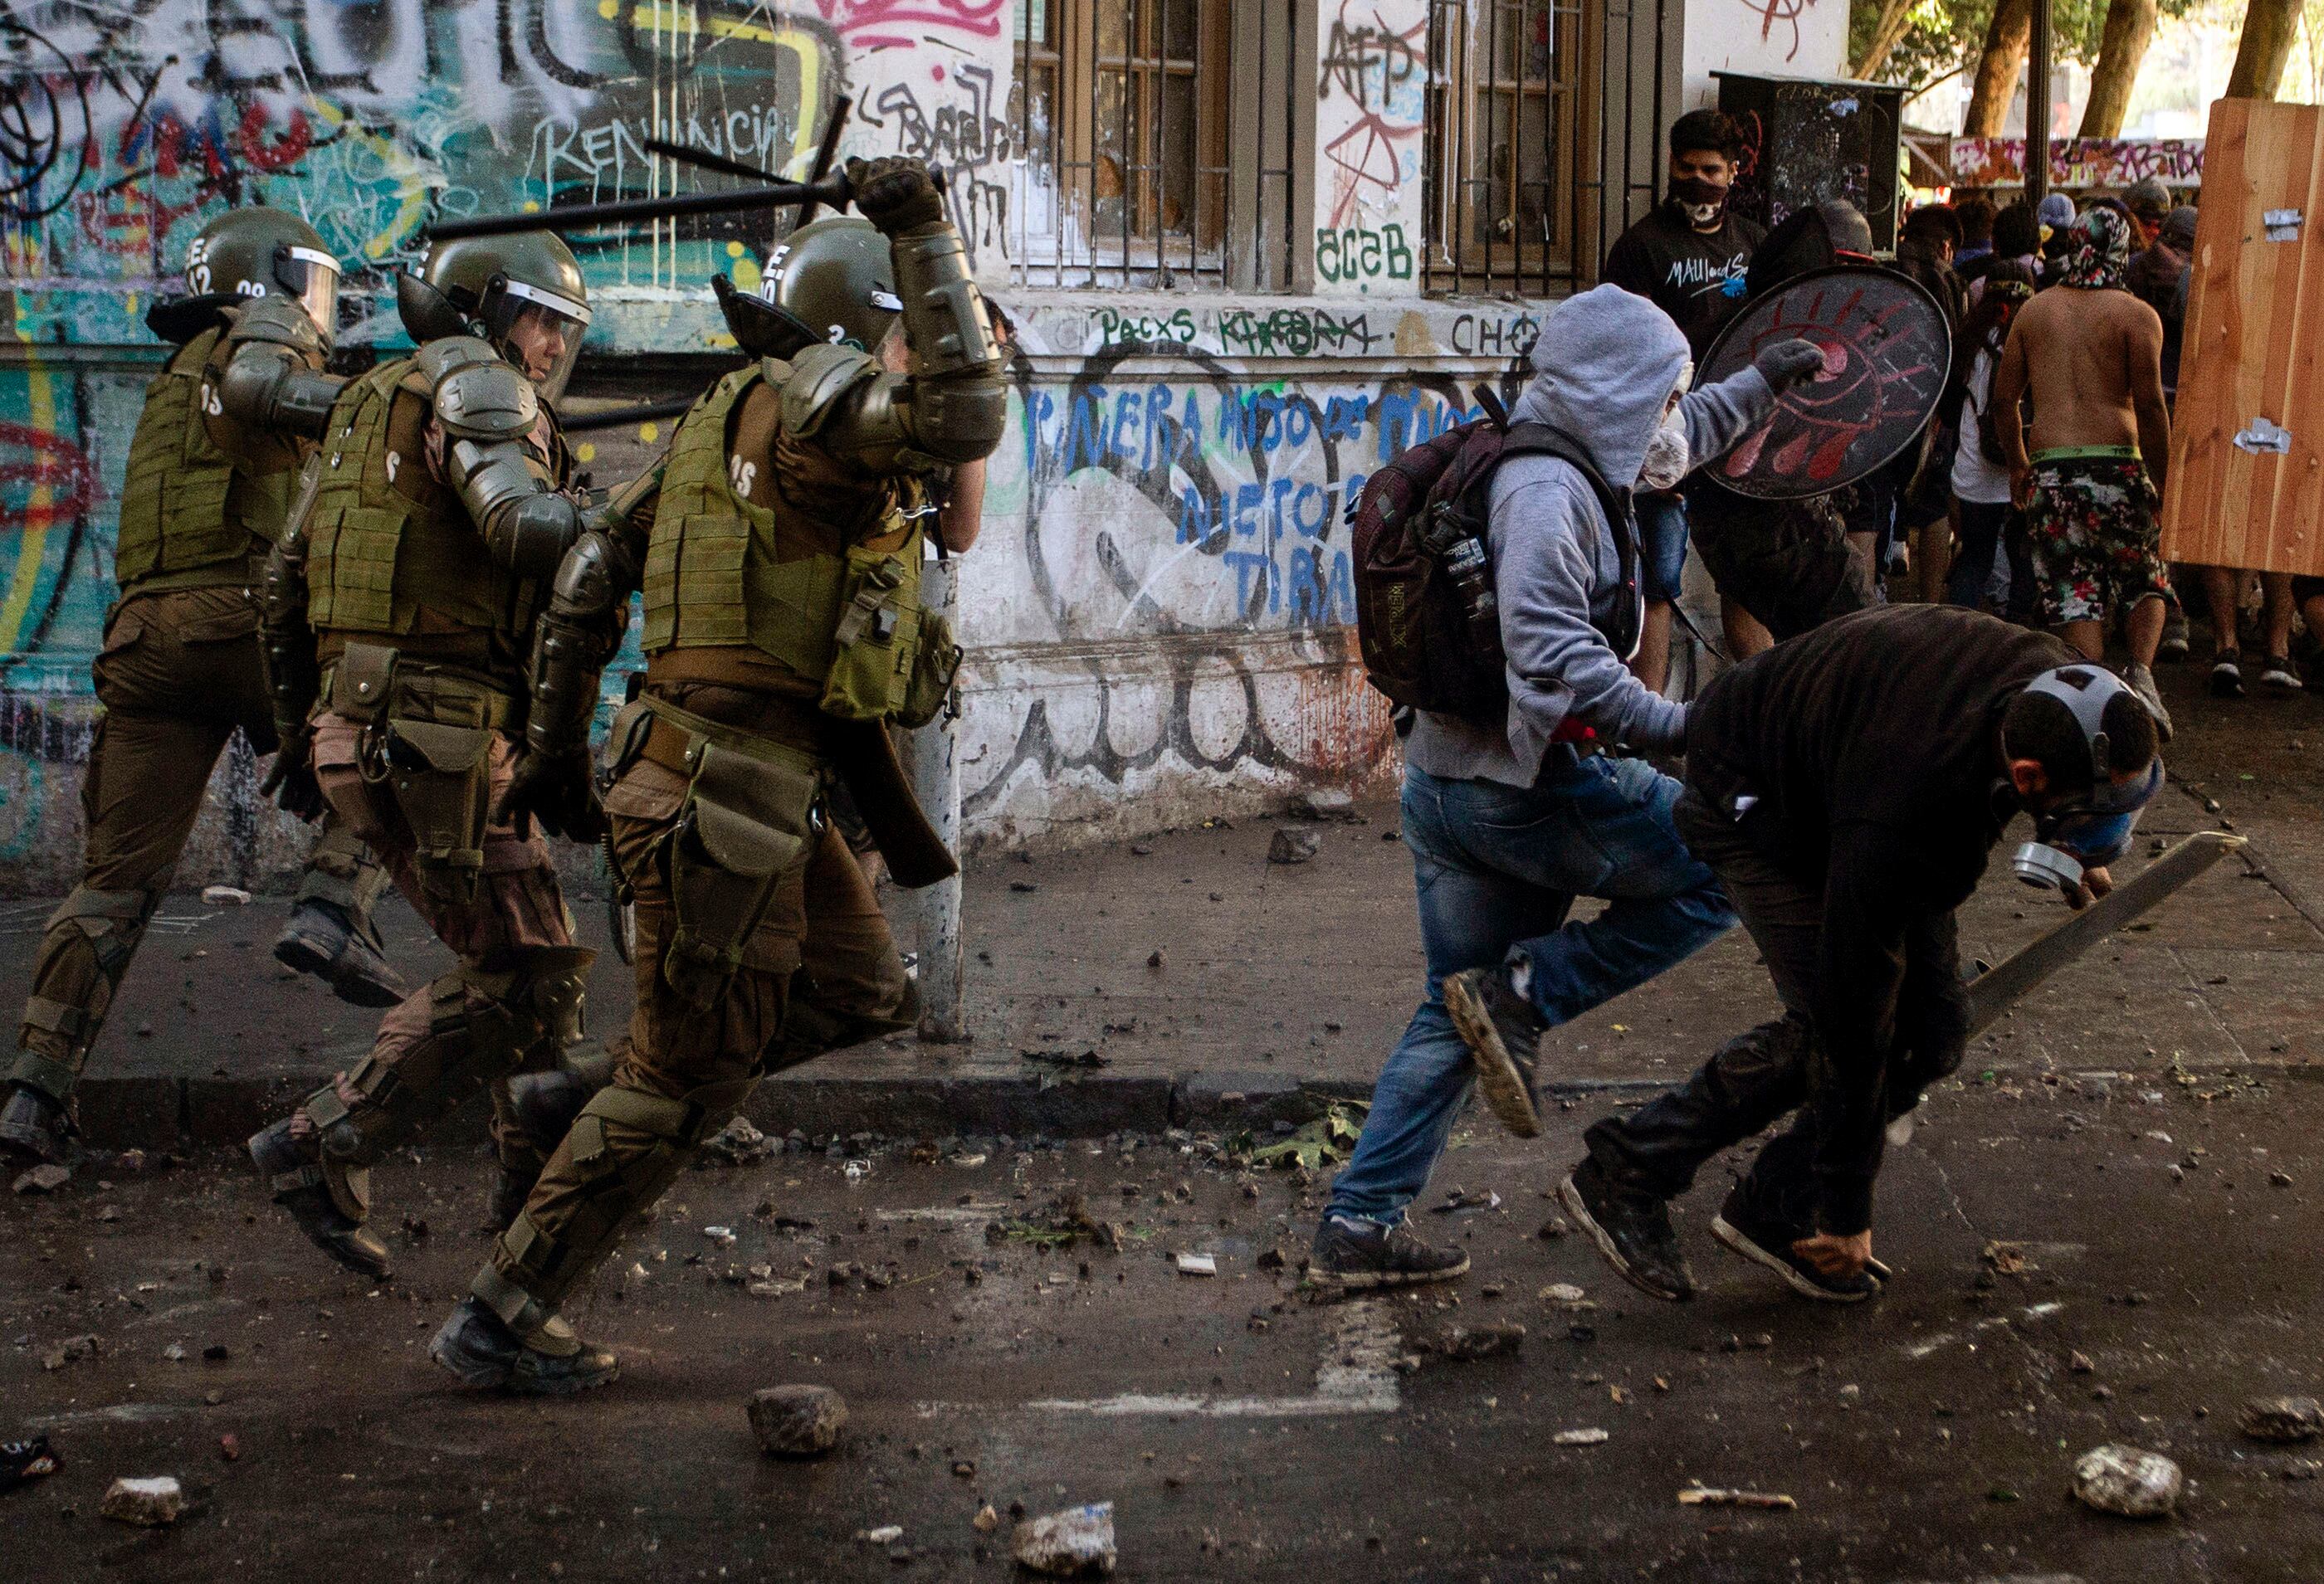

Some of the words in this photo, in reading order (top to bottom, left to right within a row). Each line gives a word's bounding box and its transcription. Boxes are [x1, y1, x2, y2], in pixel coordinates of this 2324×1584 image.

[1665, 256, 1709, 288] MAUI
[1729, 251, 1749, 280] So
[1175, 477, 1329, 545] NIETO
[1223, 546, 1359, 626] TIRA
